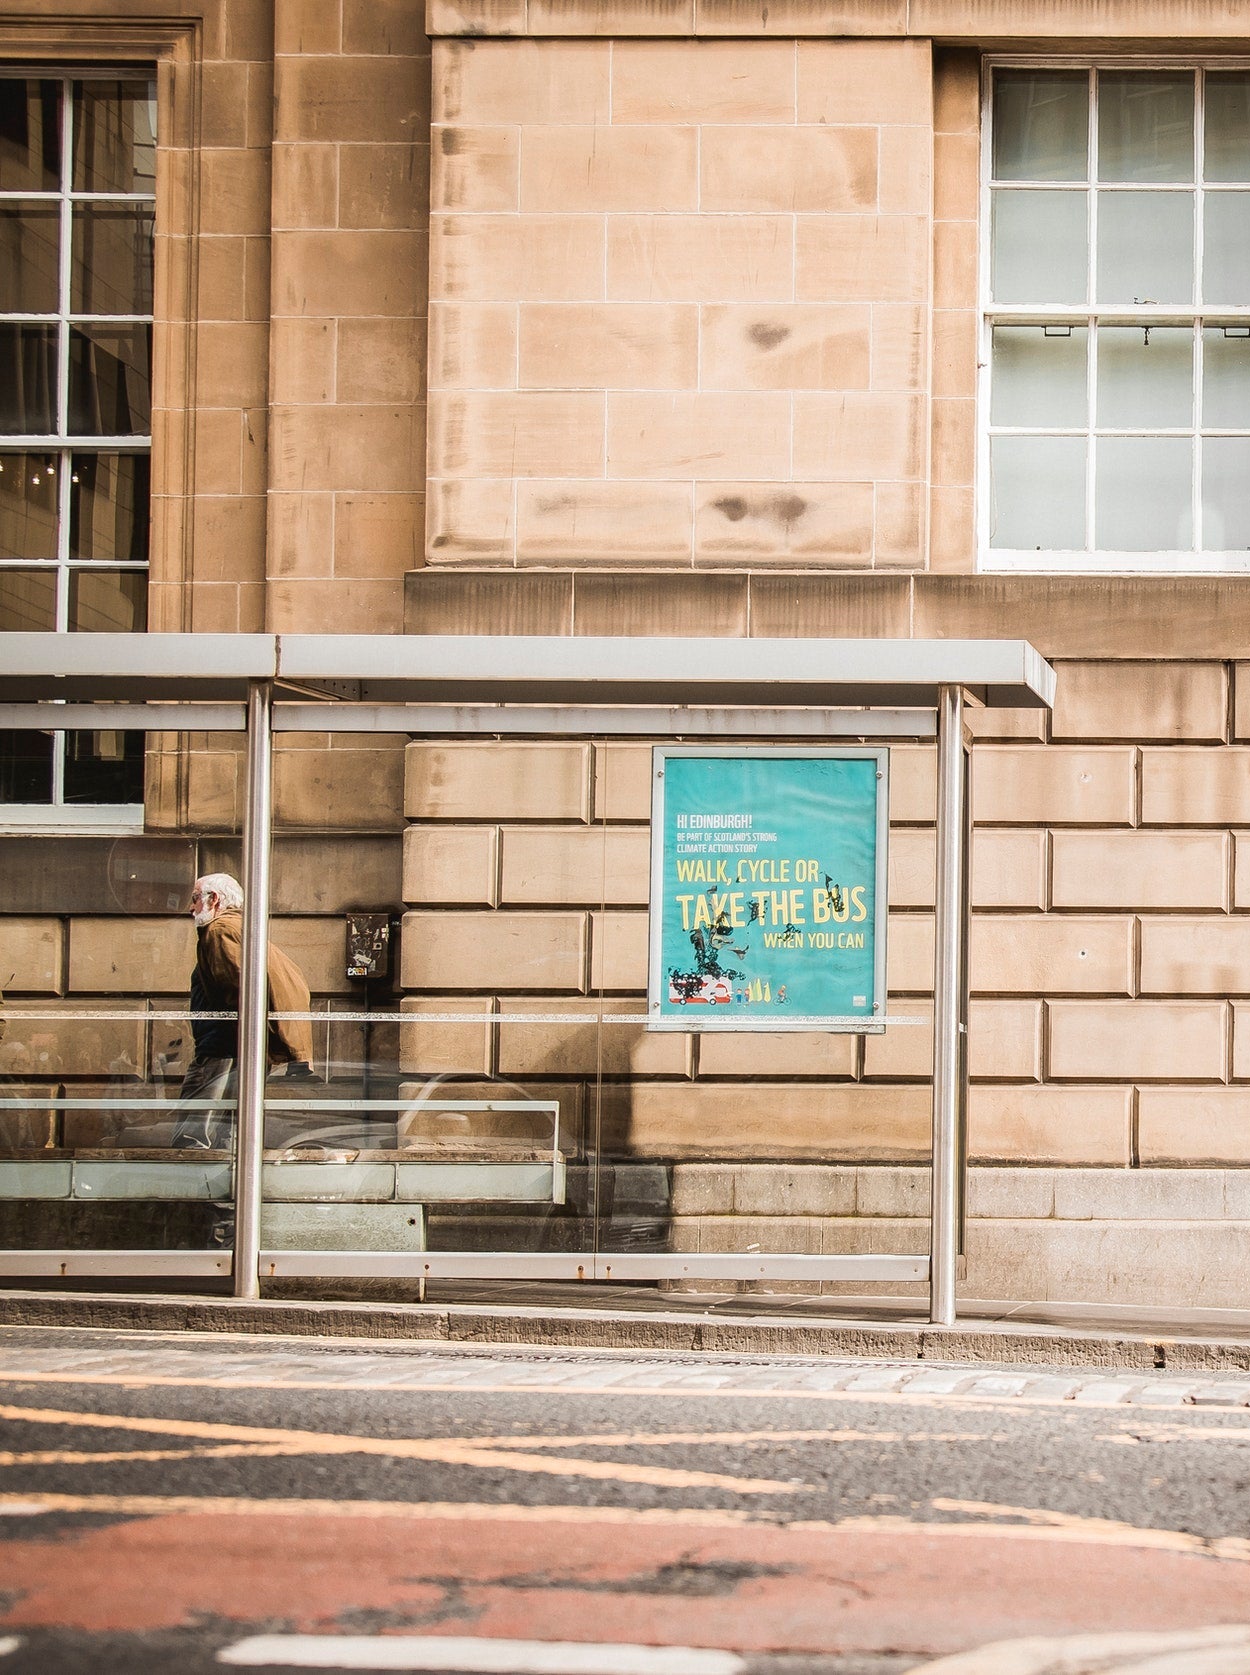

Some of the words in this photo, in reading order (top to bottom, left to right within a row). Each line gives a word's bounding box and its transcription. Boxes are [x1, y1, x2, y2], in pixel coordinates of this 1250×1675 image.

[677, 814, 688, 829] HI
[689, 814, 753, 829] EDINBURGH!
[676, 832, 686, 842] BE
[686, 832, 703, 842] PART
[704, 832, 713, 842] OF
[713, 832, 751, 842] SCOTLAND'S
[752, 832, 777, 842] STRONG
[676, 843, 707, 853] CLIMATE
[707, 843, 733, 853] ACTION
[734, 843, 758, 853] STORY
[676, 859, 732, 886] WALK,
[737, 859, 790, 883] CYCLE
[795, 859, 819, 883] OR
[675, 891, 746, 931] TAKE
[751, 889, 806, 926] THE
[812, 886, 867, 924] BUS
[763, 932, 804, 949] WHEN
[808, 932, 834, 949] YOU
[838, 932, 864, 949] CAN
